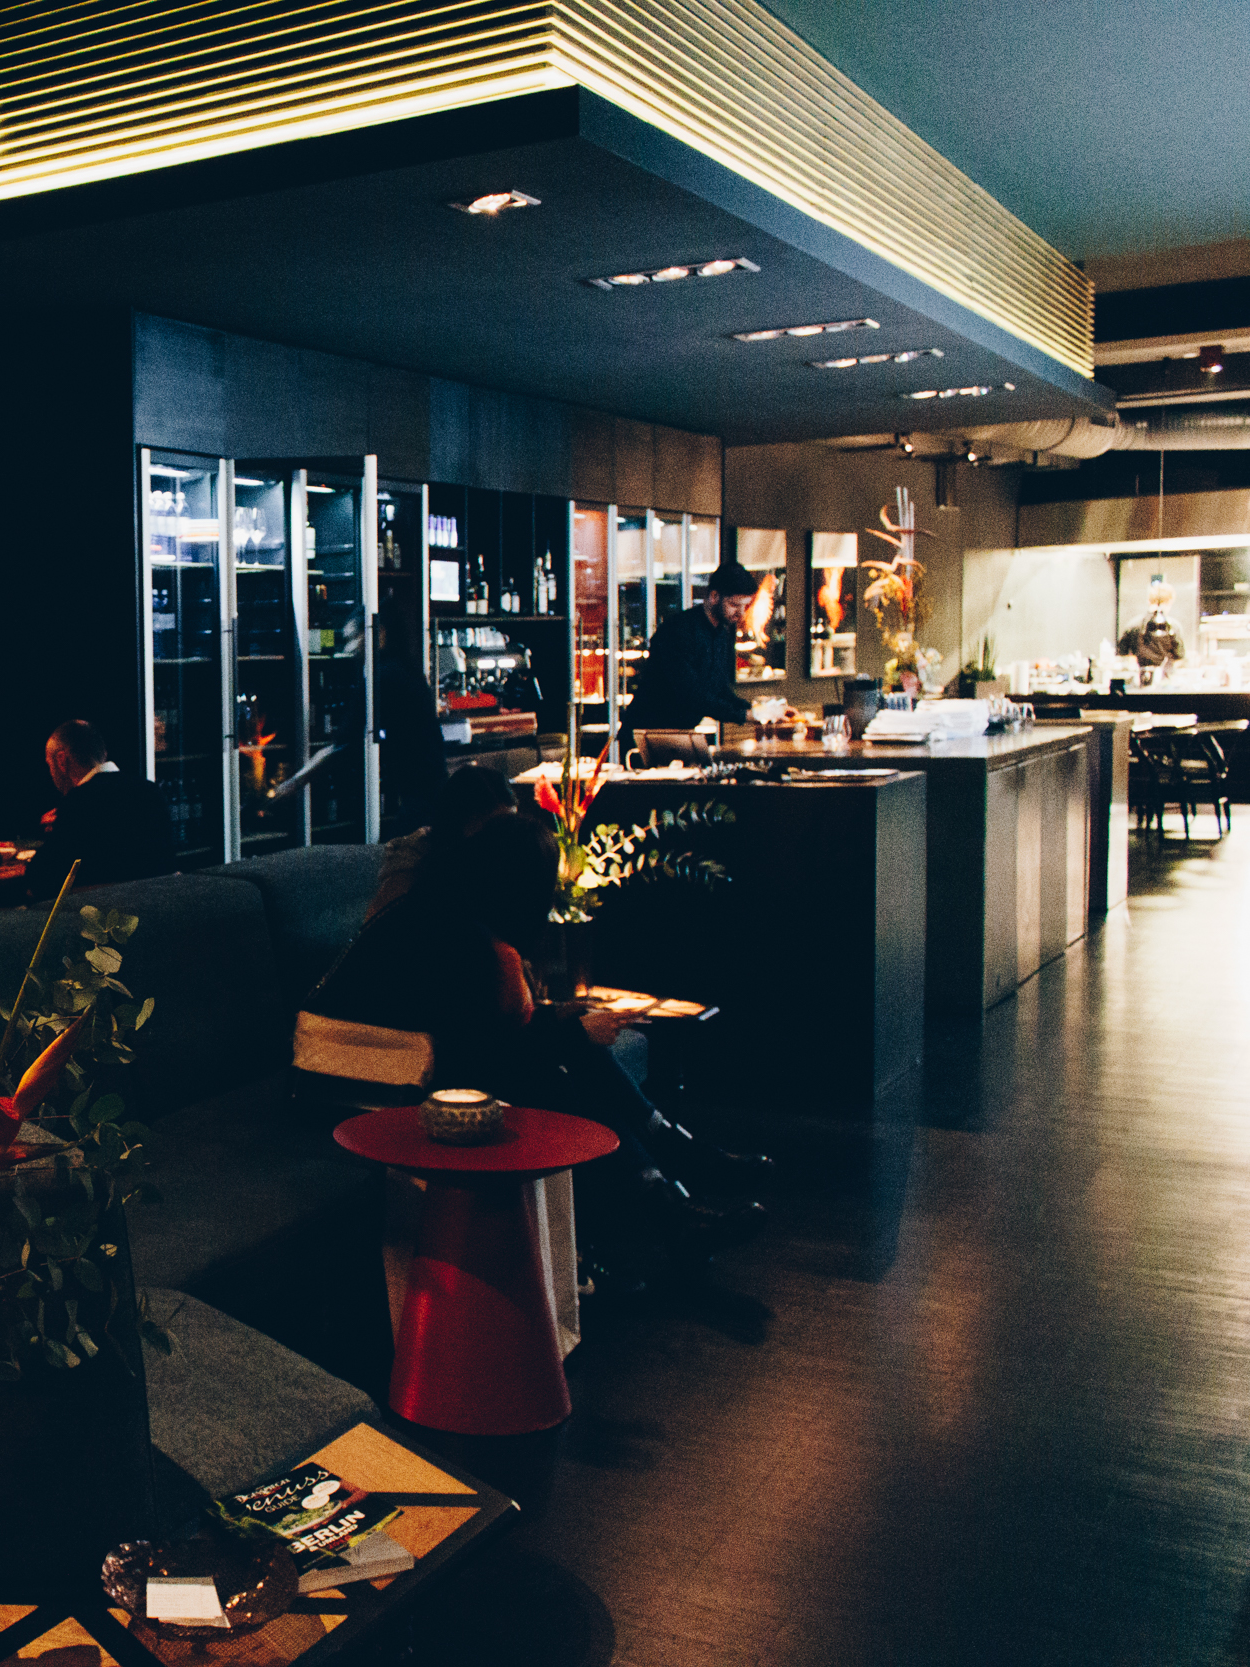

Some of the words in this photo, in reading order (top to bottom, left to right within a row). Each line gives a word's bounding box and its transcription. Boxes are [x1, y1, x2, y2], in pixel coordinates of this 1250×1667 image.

[246, 1470, 330, 1512] enuss
[264, 1494, 302, 1514] GUIDE
[287, 1510, 365, 1554] BERLIN
[318, 1524, 359, 1548] UMLAND
